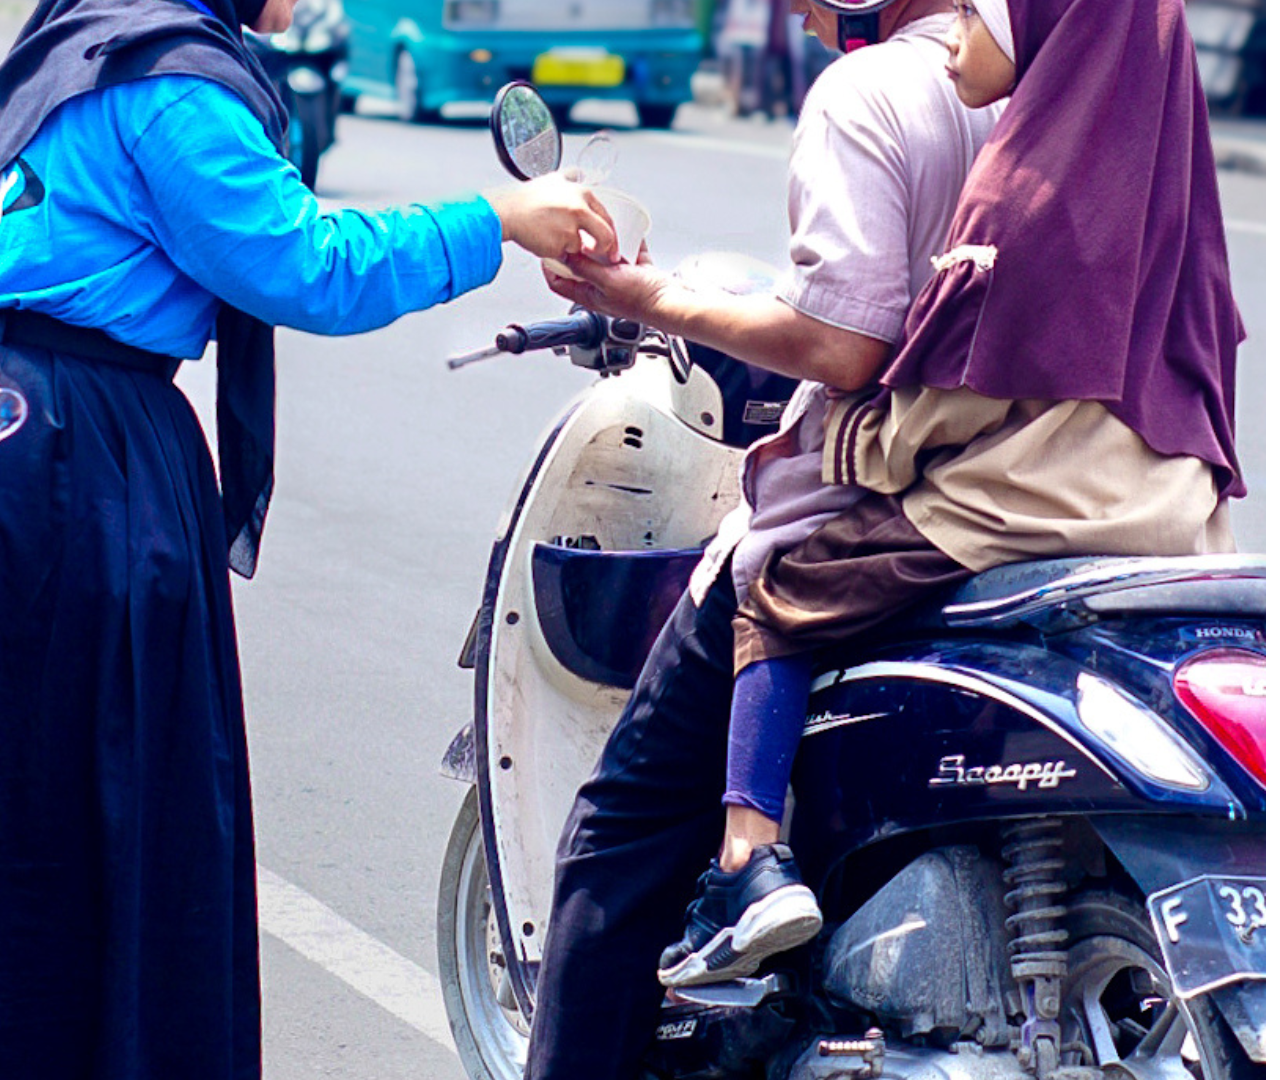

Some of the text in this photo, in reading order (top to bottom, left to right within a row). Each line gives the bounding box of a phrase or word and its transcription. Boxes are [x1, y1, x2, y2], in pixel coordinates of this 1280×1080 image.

[1196, 627, 1255, 640] HONDA
[928, 754, 1077, 791] Scoopy
[1161, 886, 1266, 943] F 33
